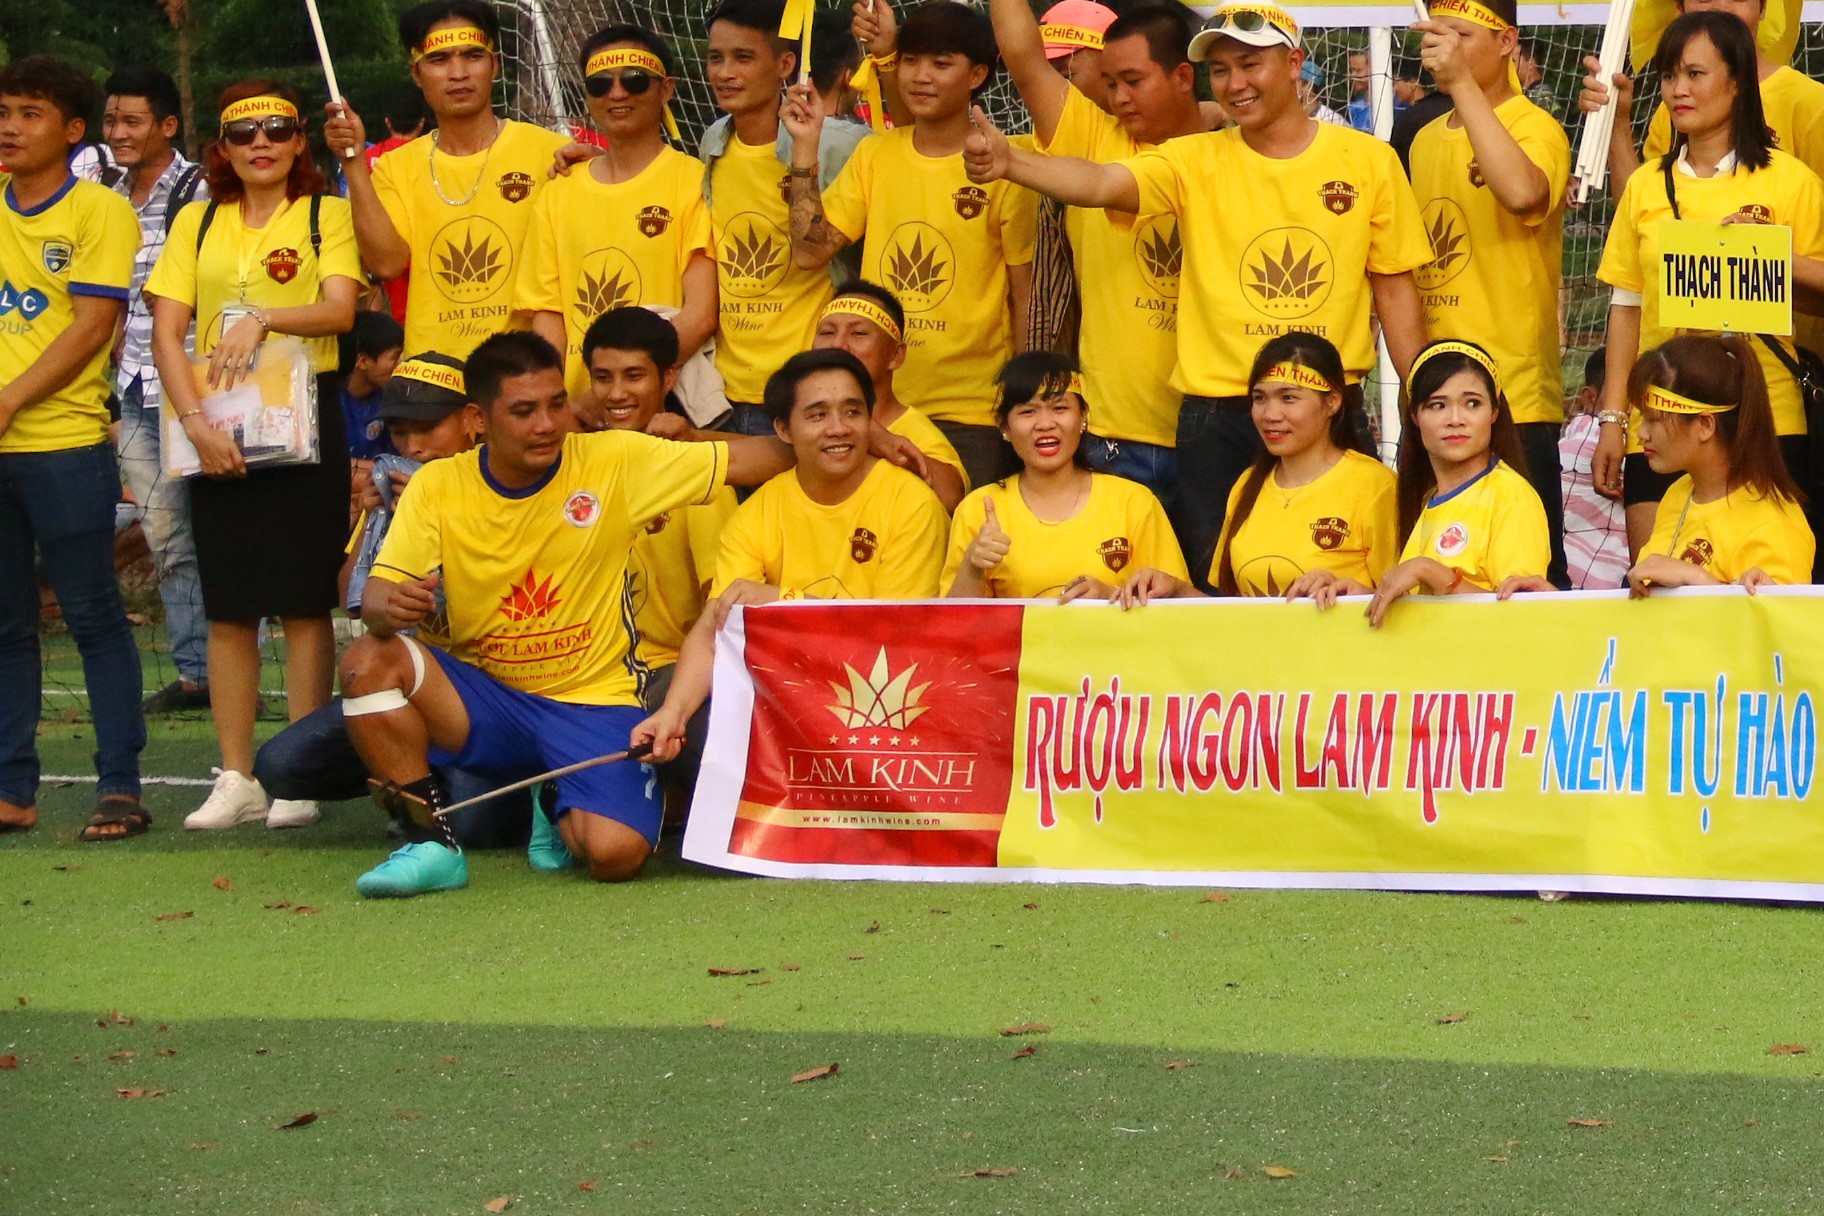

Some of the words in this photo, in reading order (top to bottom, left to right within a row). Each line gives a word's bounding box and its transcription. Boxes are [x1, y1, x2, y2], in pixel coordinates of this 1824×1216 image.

[1664, 254, 1722, 307] THẠCH
[1727, 246, 1785, 303] THÀNH
[720, 303, 740, 313] AM
[747, 302, 783, 313] KINH
[1135, 297, 1166, 312] LAM
[1426, 295, 1459, 307] KINH
[439, 310, 465, 323] LAM
[471, 305, 509, 318] KINH
[908, 318, 946, 332] KINH
[1244, 323, 1280, 335] LAM
[513, 641, 548, 656] LAM
[554, 629, 592, 650] KINH
[1024, 675, 1151, 829] RƯỢU
[1157, 690, 1286, 795] NGON
[1293, 691, 1399, 798] LAM
[1403, 691, 1516, 826] KINH
[1663, 673, 1726, 833] TỰ
[1734, 654, 1817, 800] HÀO
[788, 756, 855, 784] LAM
[870, 757, 976, 792] KINH
[796, 793, 891, 804] PINEAPPLE
[909, 795, 961, 805] WINE
[802, 815, 941, 826] www.lamkinhwine.com
